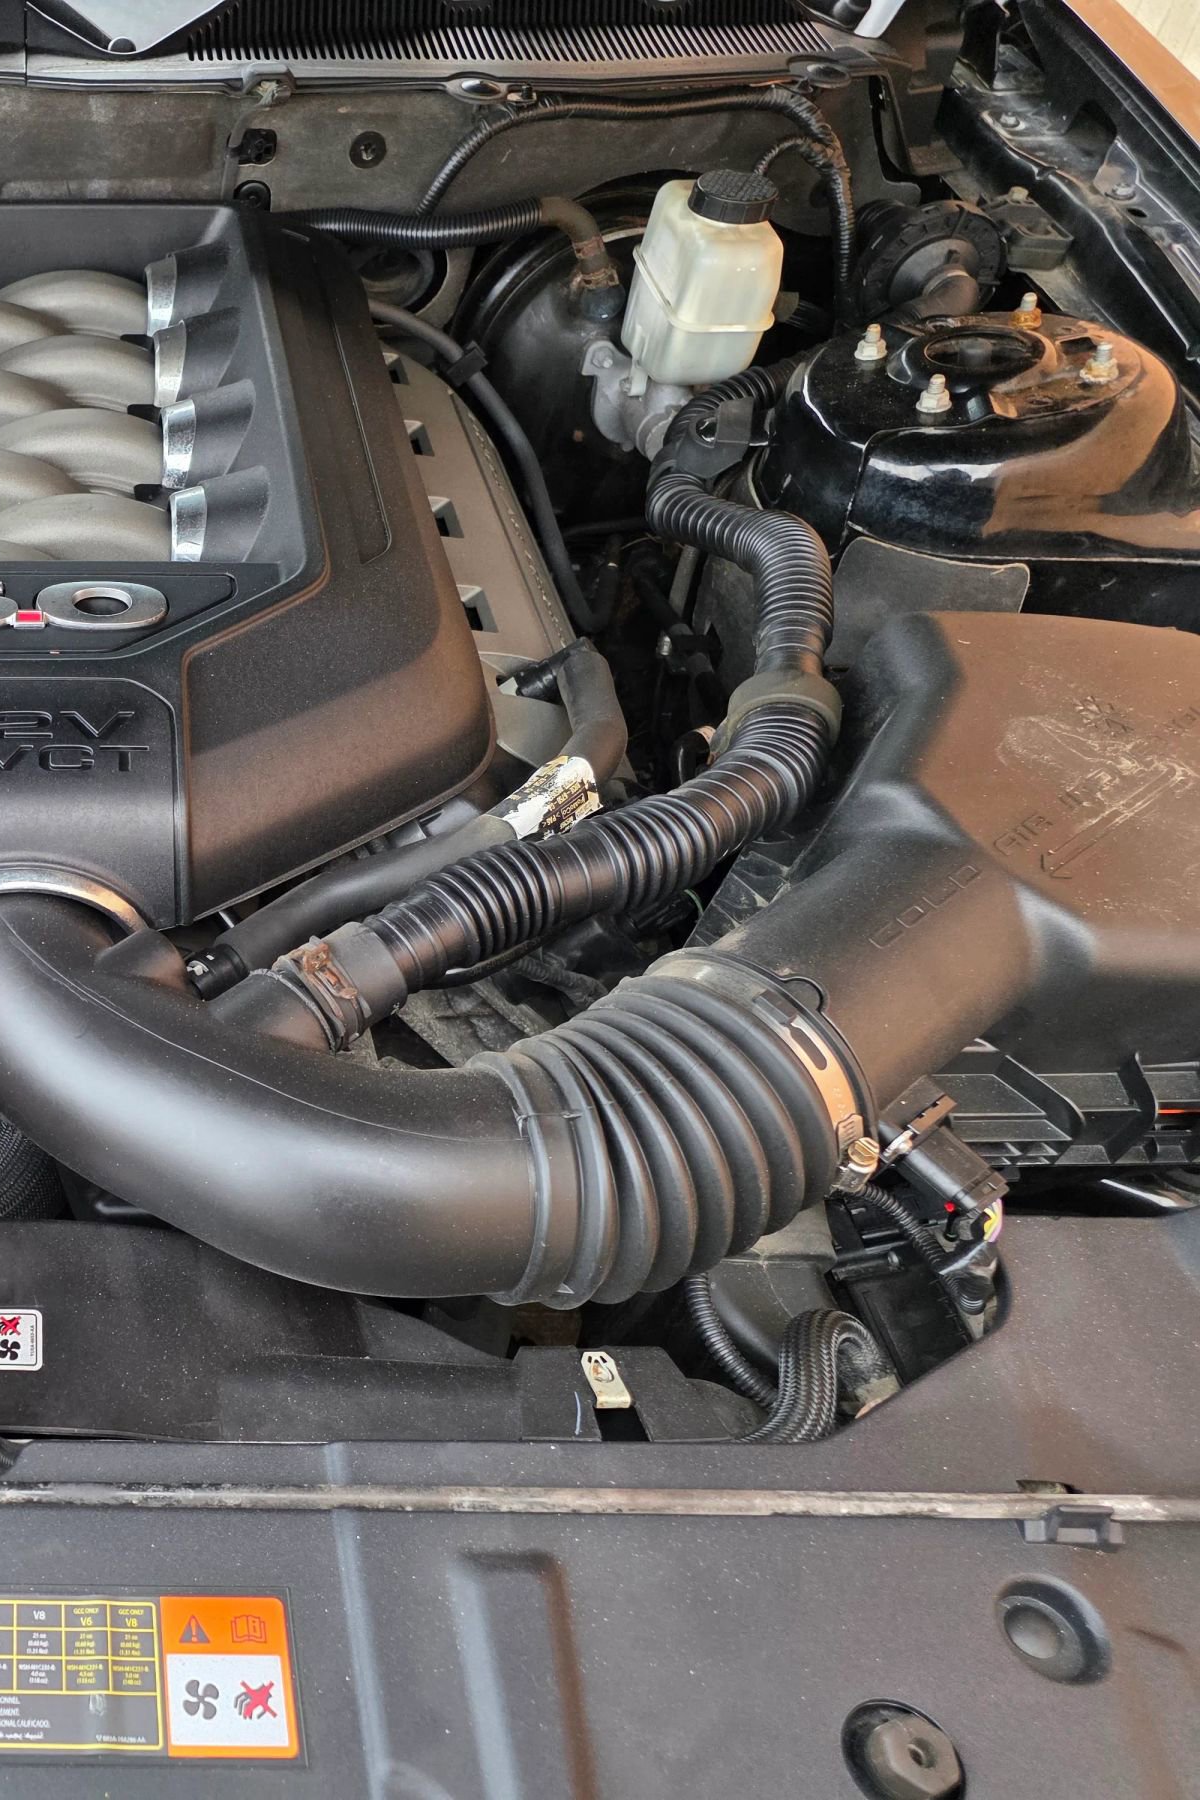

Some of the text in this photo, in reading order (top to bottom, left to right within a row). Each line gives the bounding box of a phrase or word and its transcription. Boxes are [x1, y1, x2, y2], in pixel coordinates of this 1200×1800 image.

[993, 813, 1054, 856] AIR
[869, 865, 981, 949] COLD
[33, 1610, 46, 1620] V8
[80, 1617, 92, 1626] V6
[125, 1618, 138, 1627] V8
